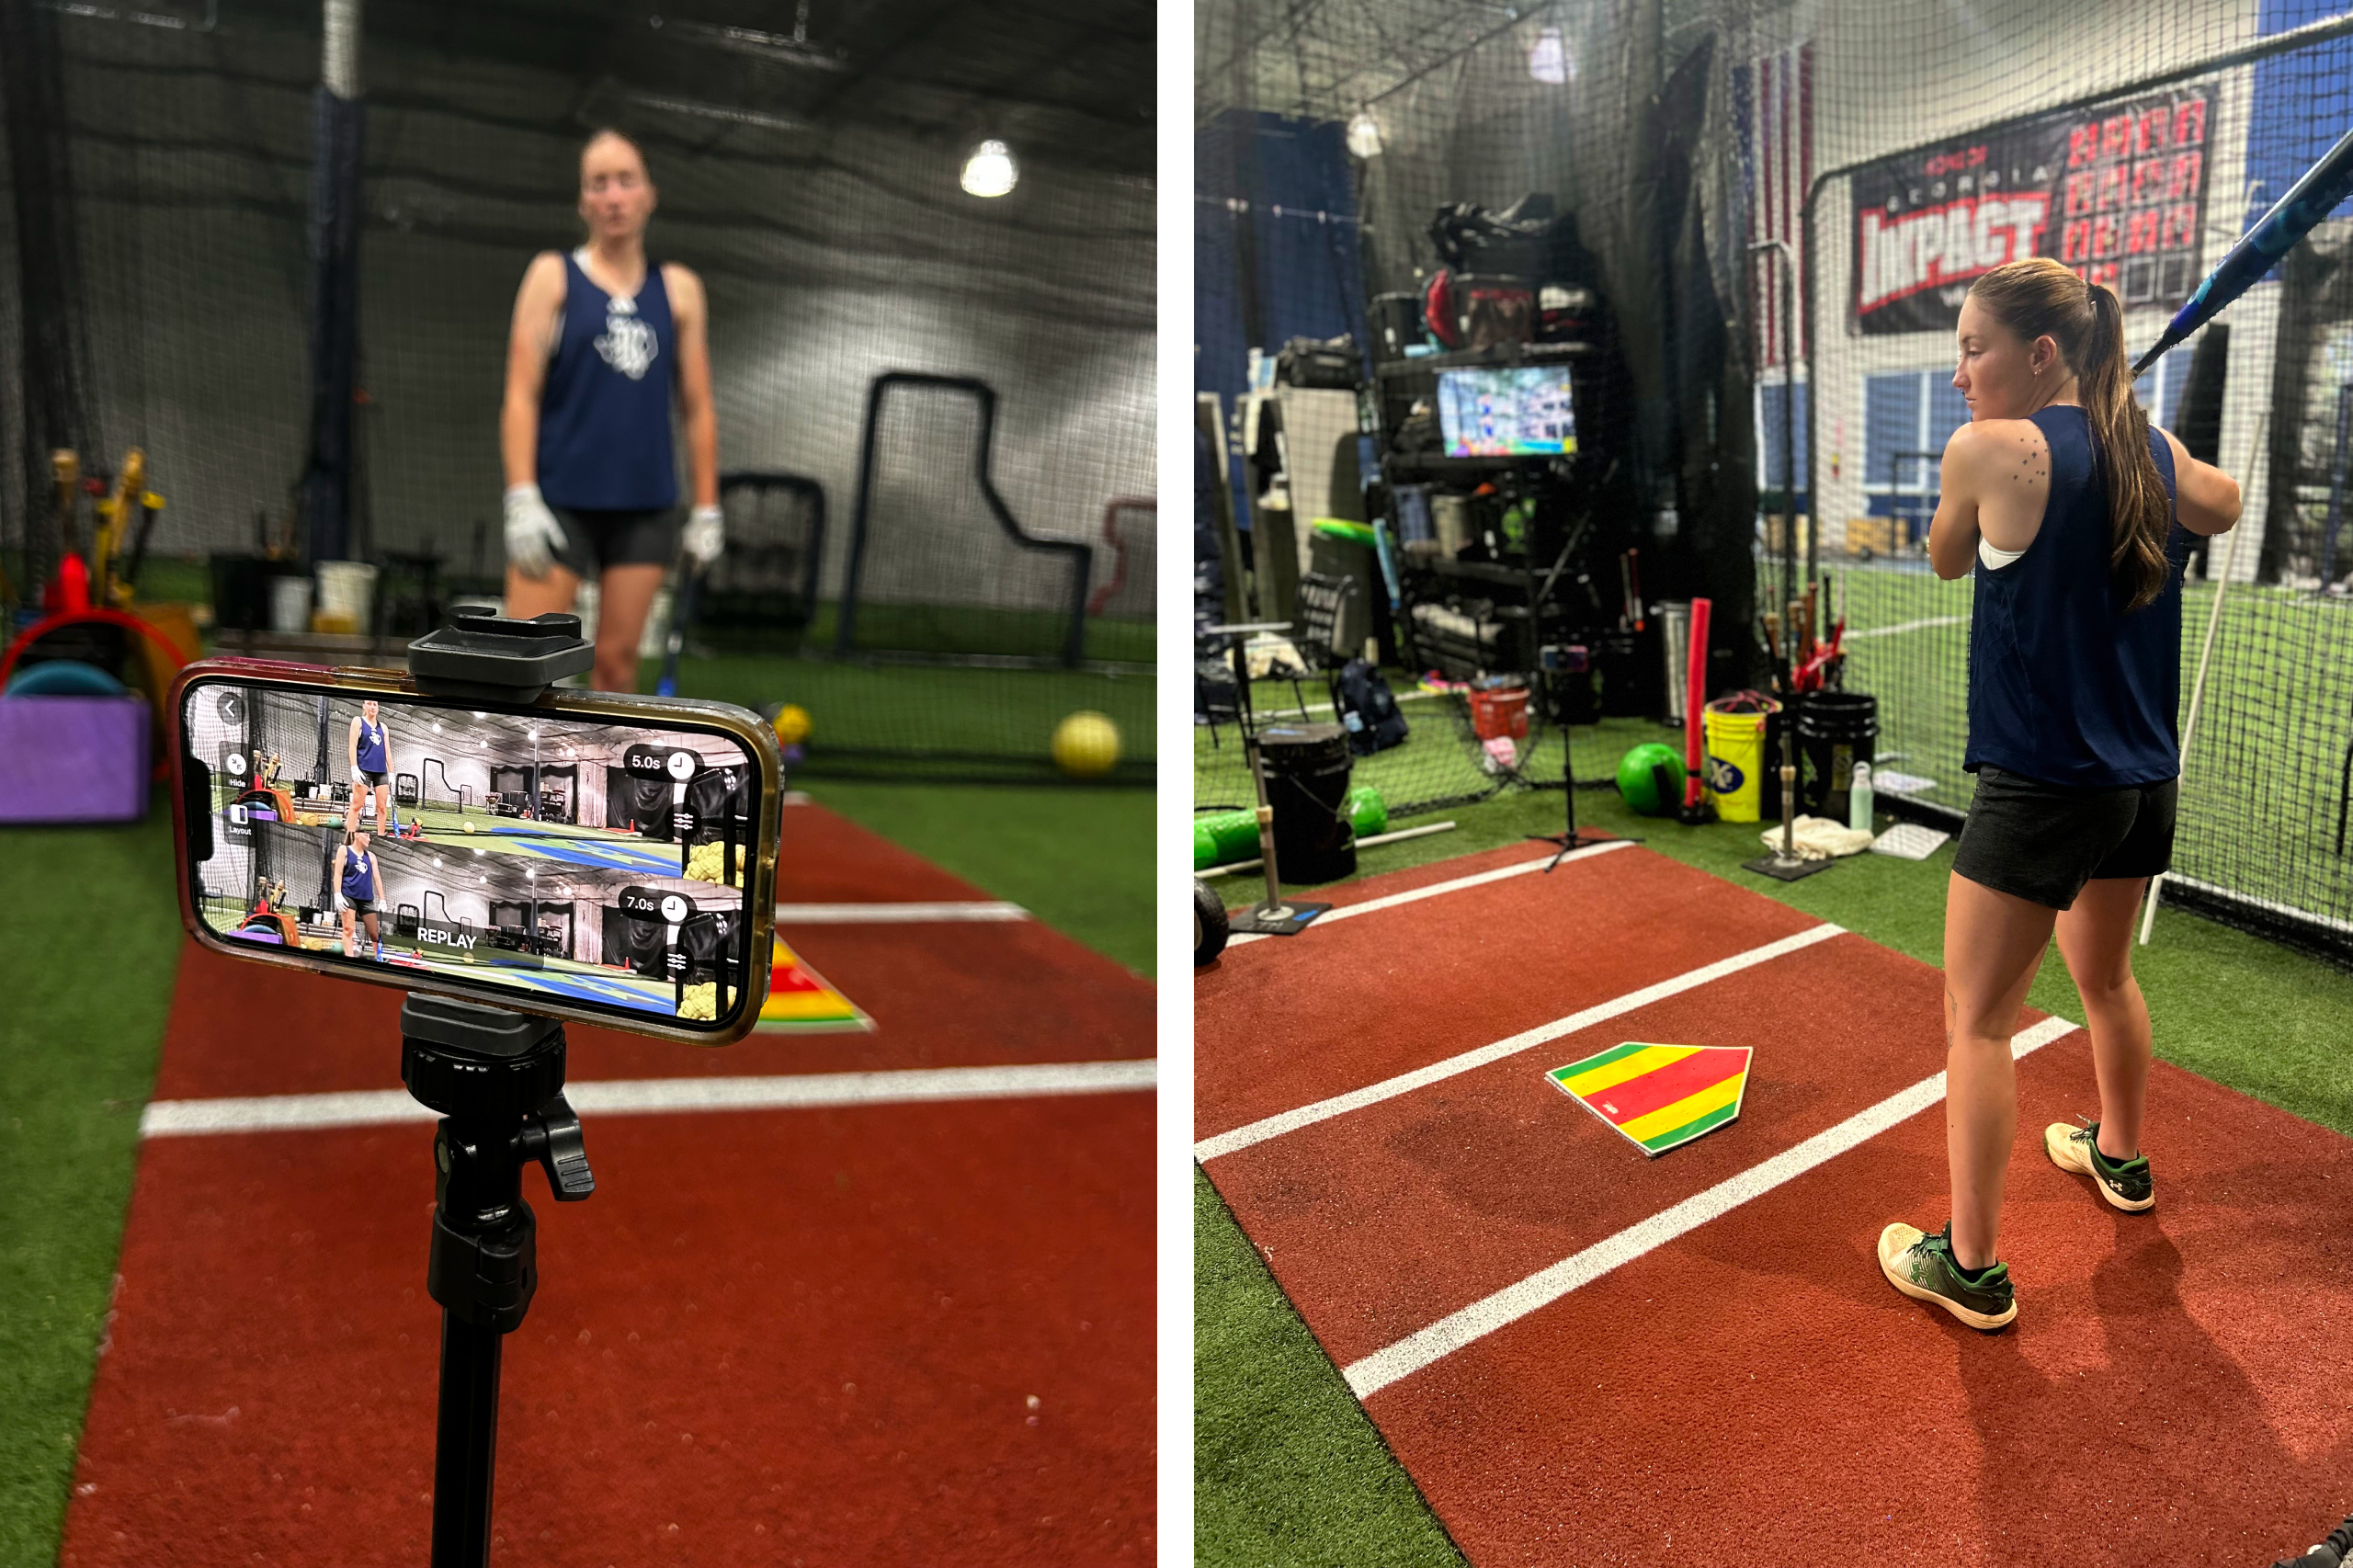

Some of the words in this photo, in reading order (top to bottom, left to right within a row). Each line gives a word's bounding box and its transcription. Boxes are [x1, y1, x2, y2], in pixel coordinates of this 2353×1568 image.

[1886, 165, 2049, 213] GEORGIA
[1859, 199, 2046, 309] IMPACT
[631, 755, 661, 770] 5.0s
[229, 778, 246, 789] Hide
[229, 825, 252, 836] Layout
[626, 896, 654, 912] 7.0s
[417, 926, 477, 950] REPLAY
